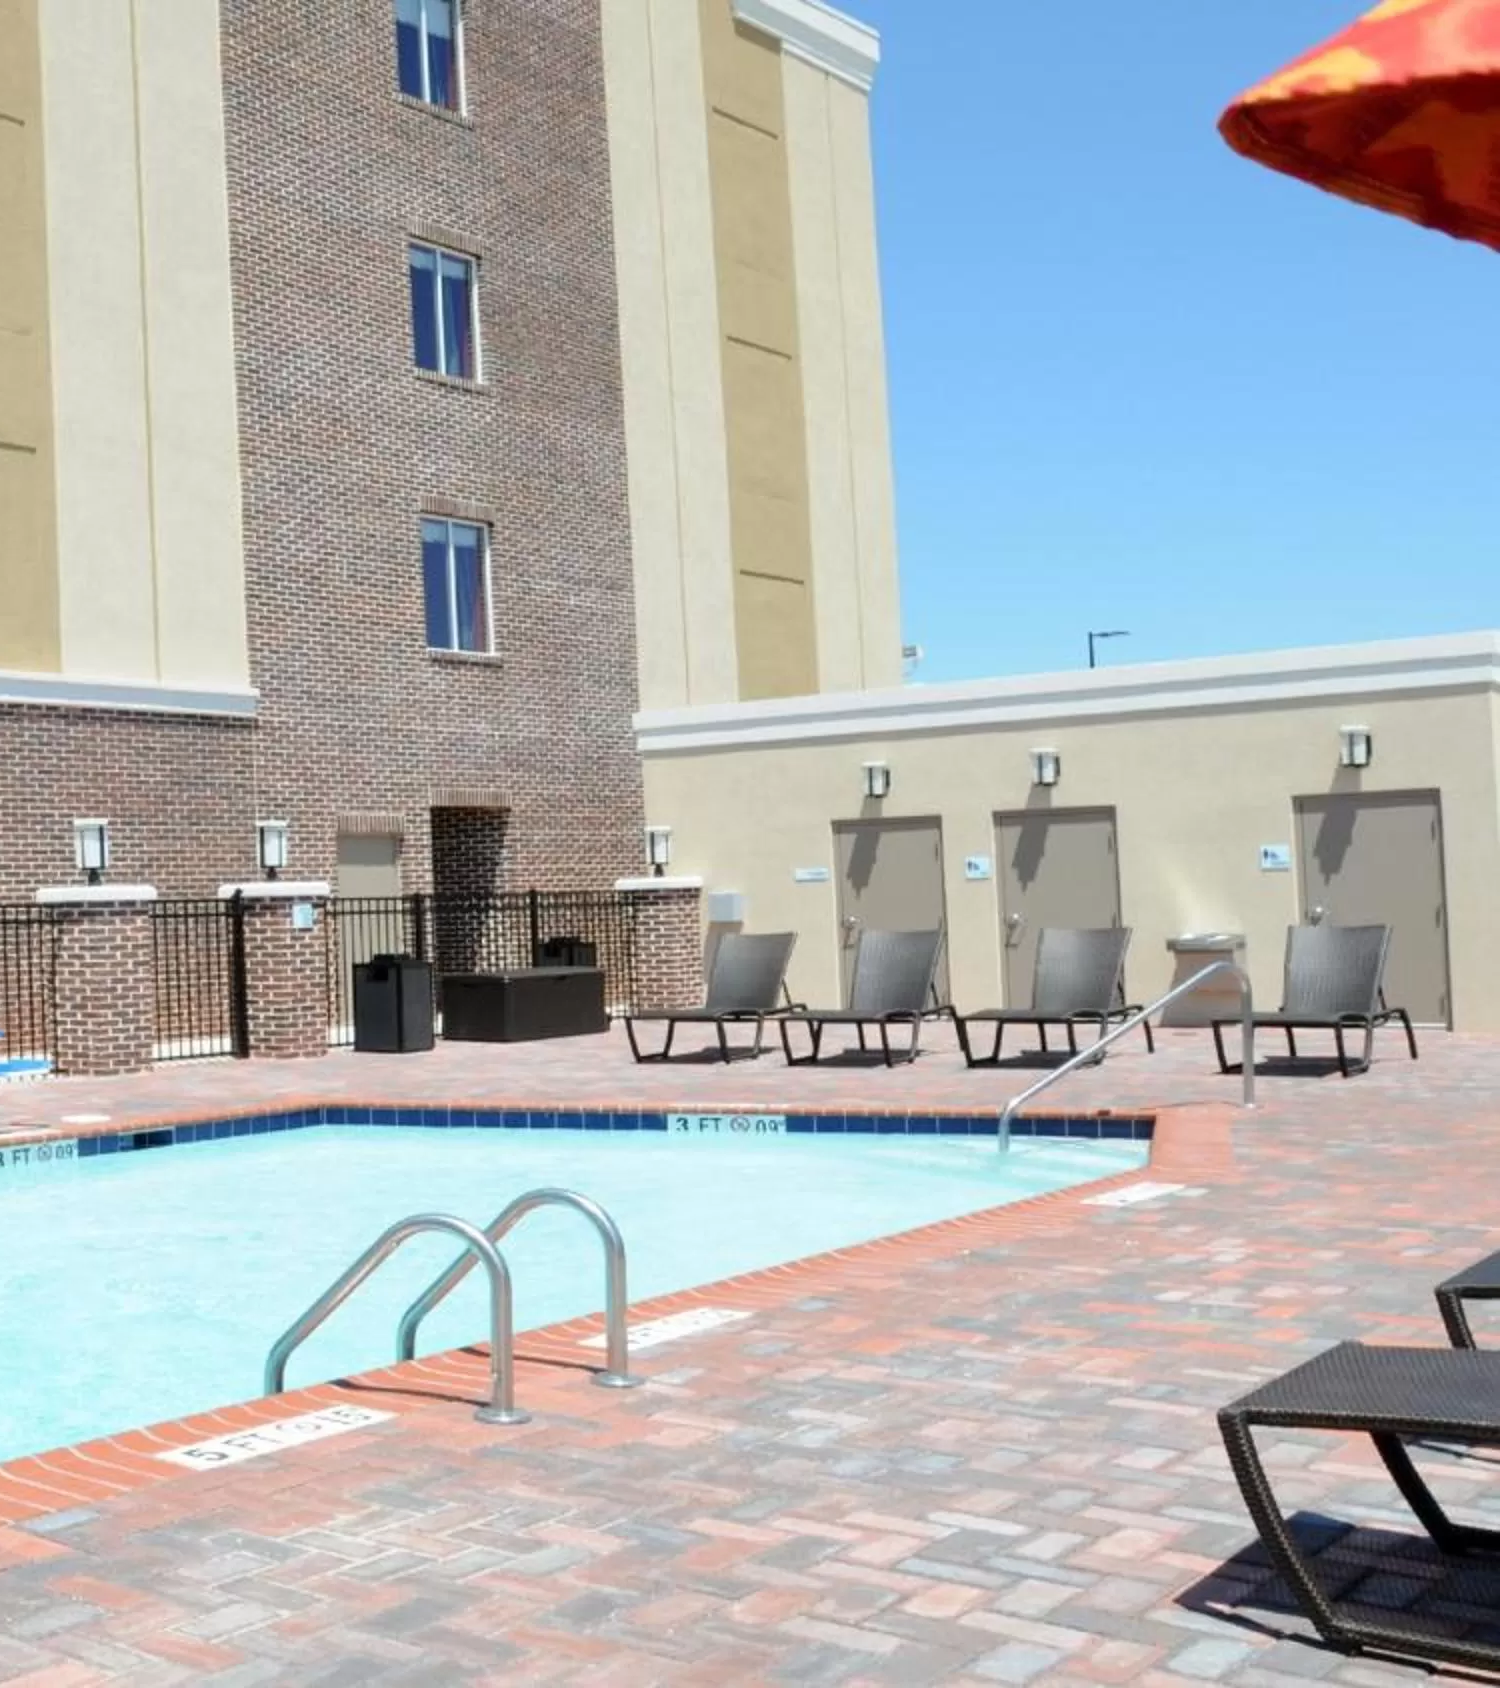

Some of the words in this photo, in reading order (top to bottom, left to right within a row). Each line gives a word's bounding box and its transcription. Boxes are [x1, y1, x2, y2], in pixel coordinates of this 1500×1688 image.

[676, 1116, 689, 1132] 3
[698, 1117, 722, 1133] FT
[12, 1147, 30, 1166] FT
[181, 1447, 229, 1461] 5
